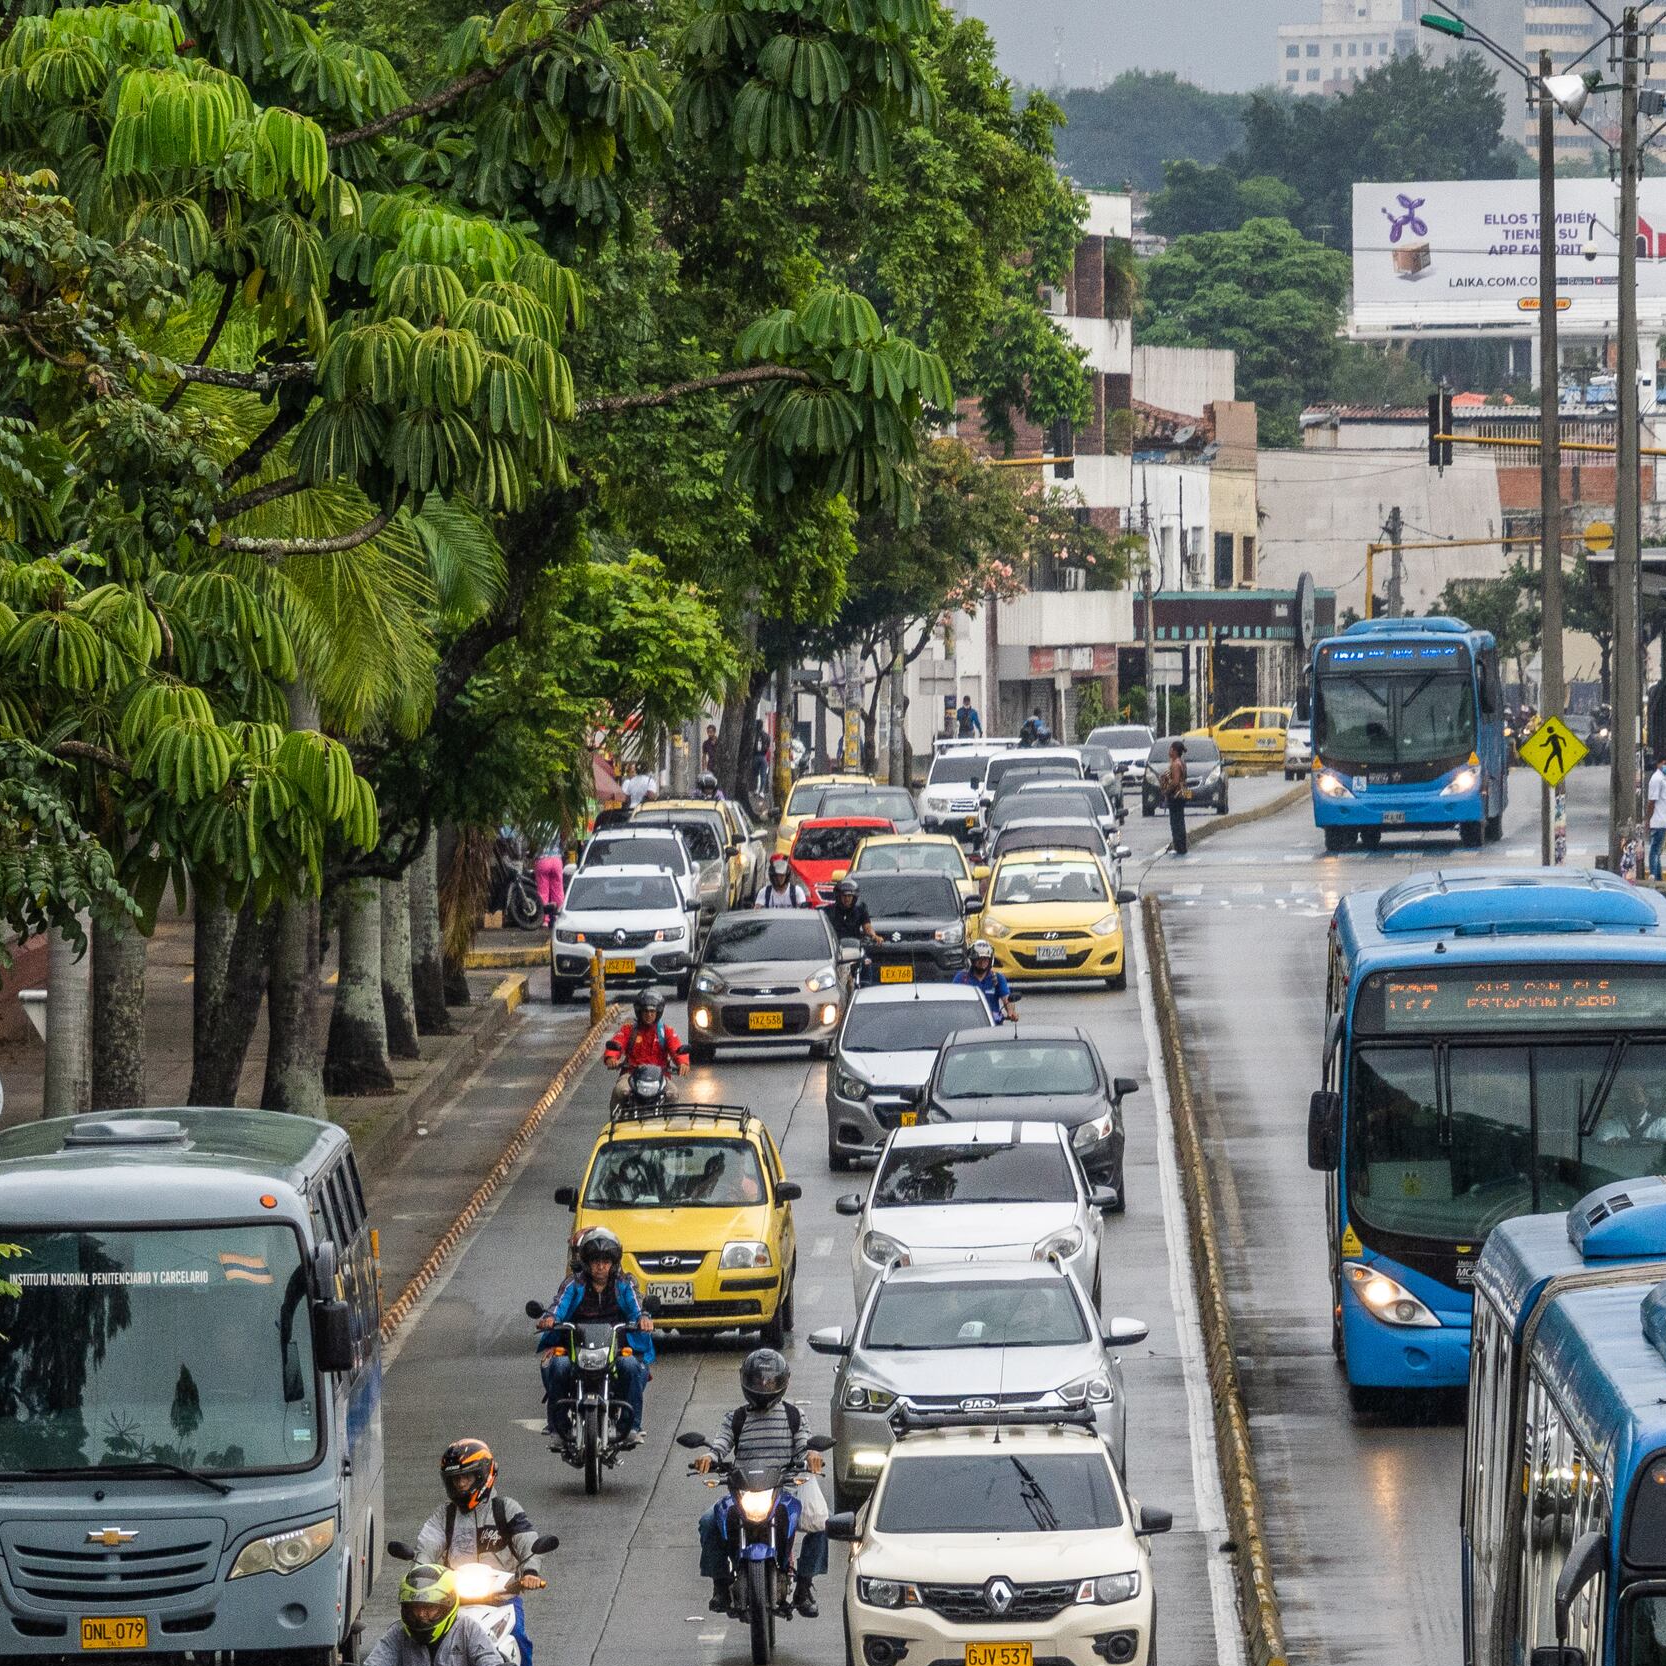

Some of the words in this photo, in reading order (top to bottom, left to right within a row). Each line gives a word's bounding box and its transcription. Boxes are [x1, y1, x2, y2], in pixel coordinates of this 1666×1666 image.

[1484, 214, 1528, 225] ELLOS
[1502, 229, 1541, 241] TIENE
[1558, 228, 1578, 240] SU
[1488, 245, 1518, 256] APP
[1449, 276, 1538, 288] LAIKA.COM.CO
[9, 1273, 48, 1286] INSTITUTO
[50, 1273, 90, 1286] NACIONAL
[92, 1271, 152, 1285] PENITENCIARIO
[152, 1271, 159, 1284] Y
[160, 1270, 209, 1284] CARCELARIO
[968, 1648, 997, 1666] GJV
[1000, 1648, 1030, 1666] 537
